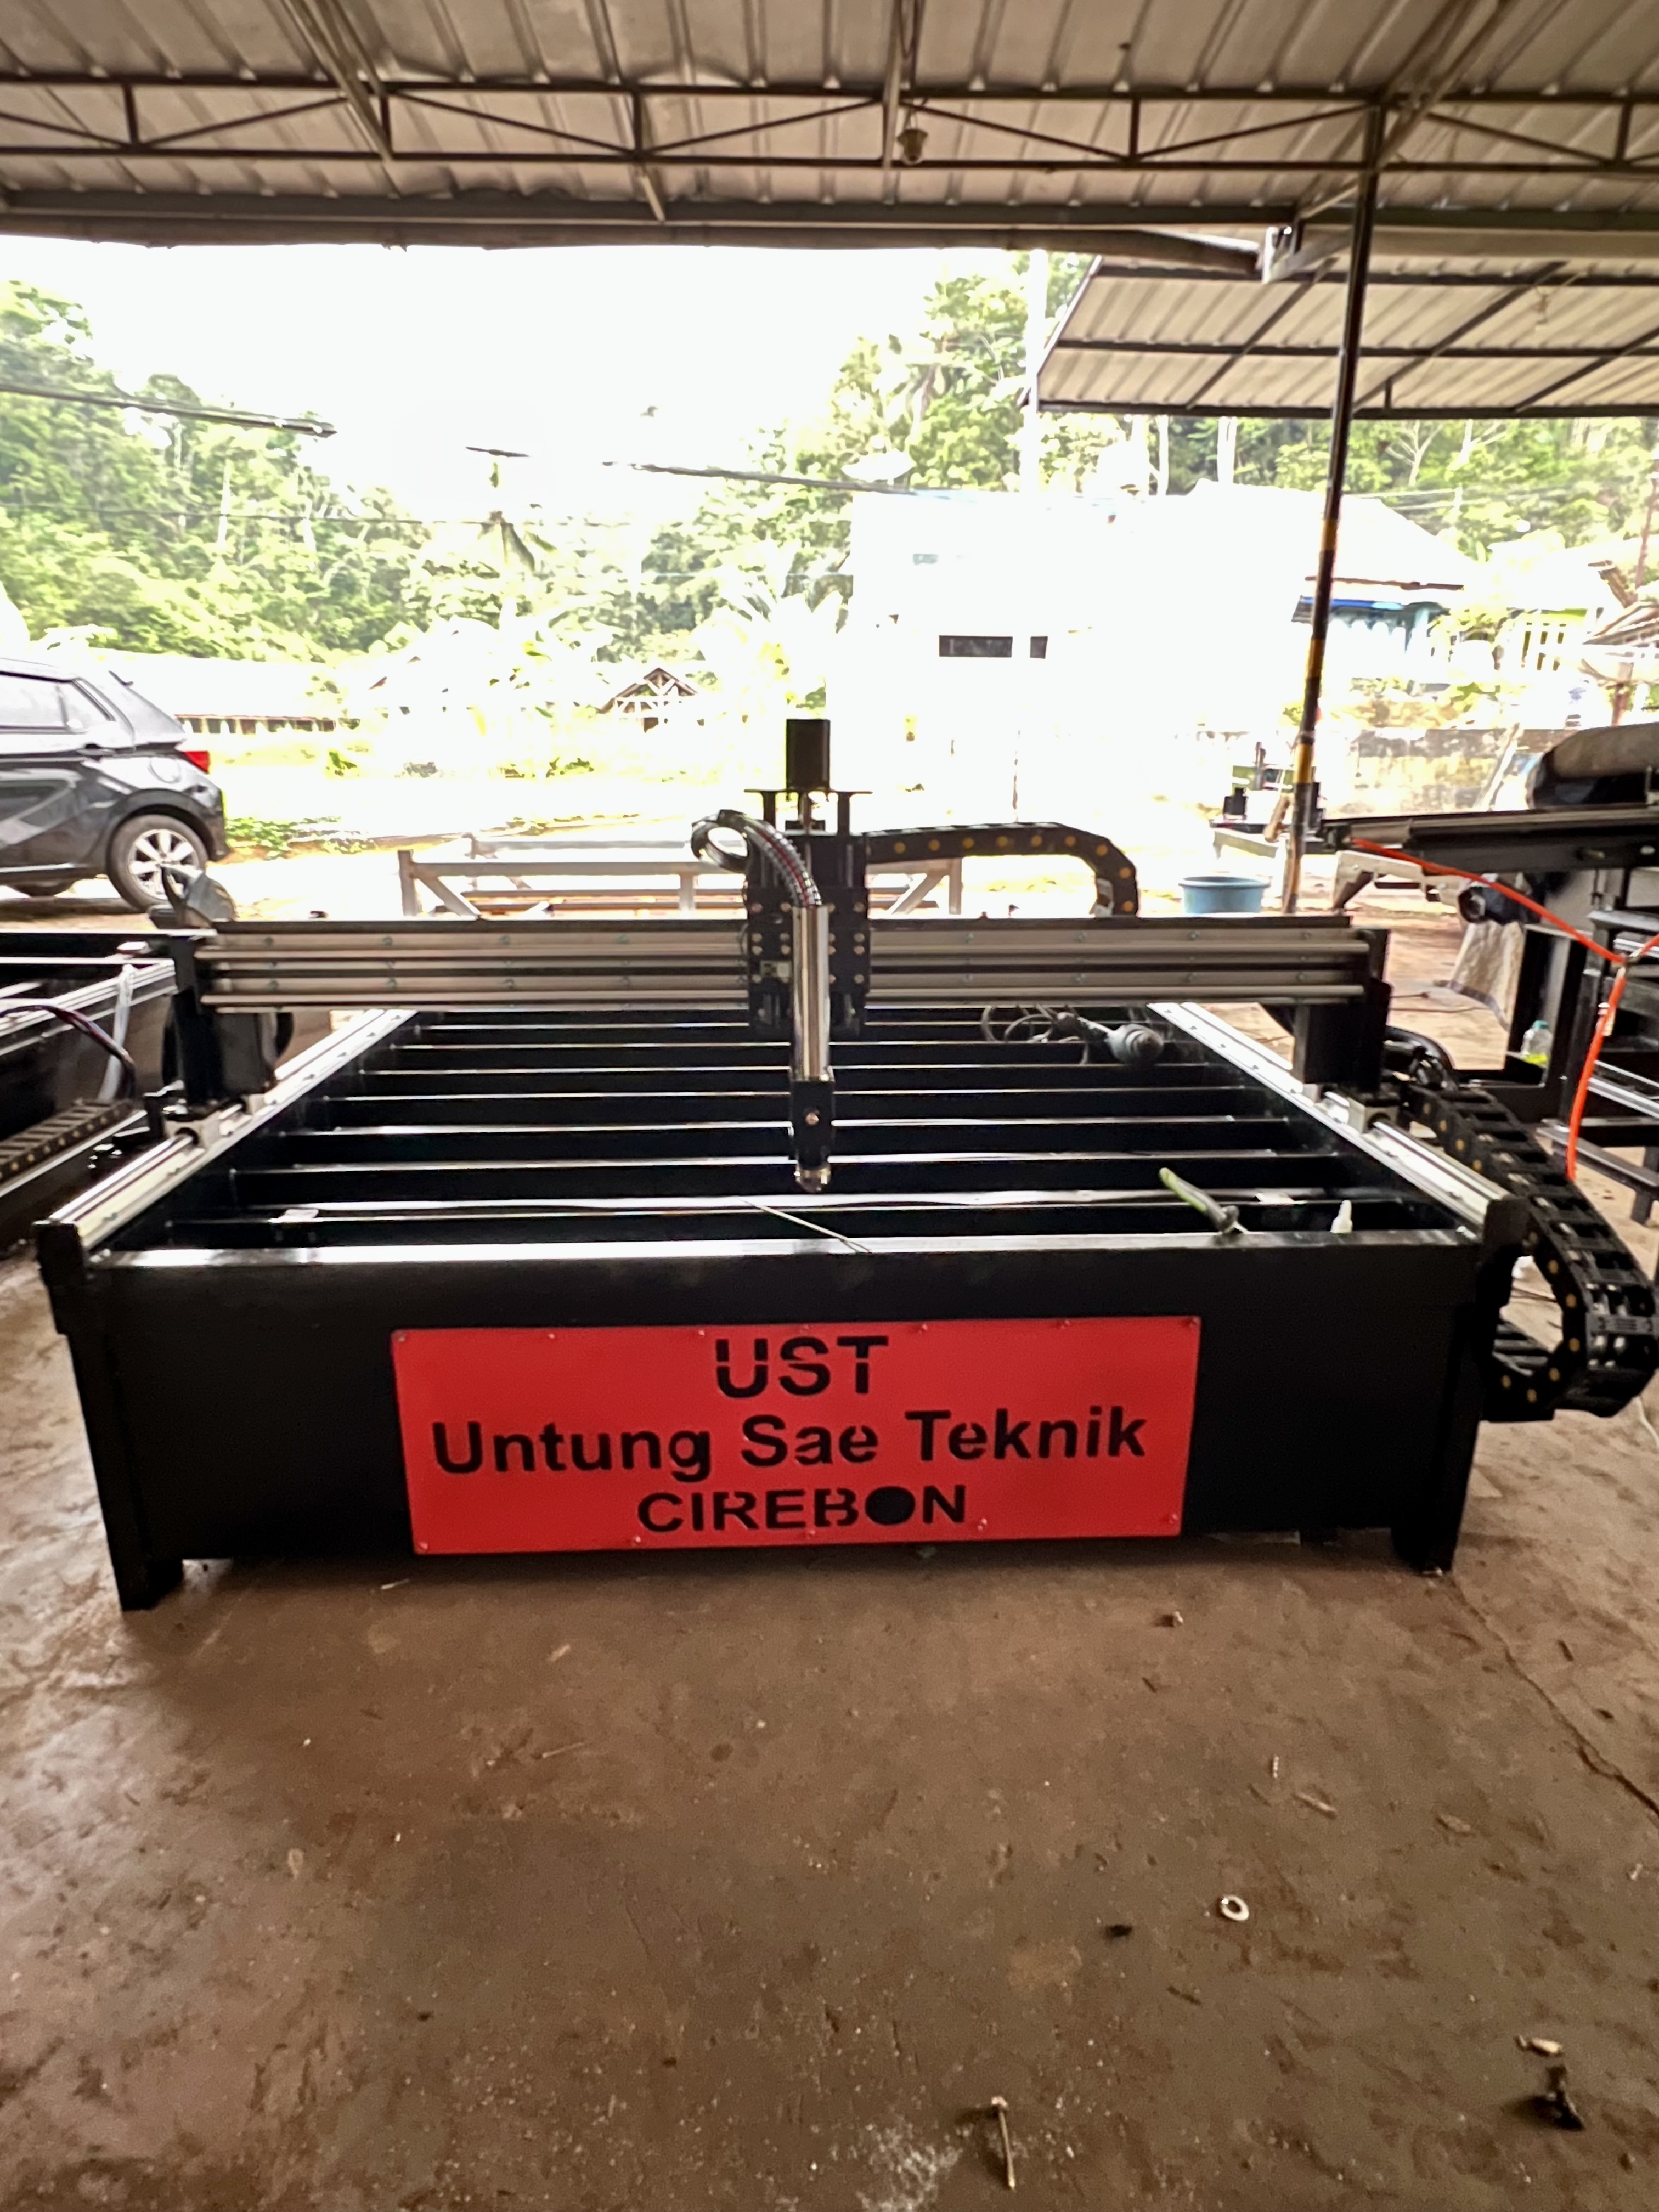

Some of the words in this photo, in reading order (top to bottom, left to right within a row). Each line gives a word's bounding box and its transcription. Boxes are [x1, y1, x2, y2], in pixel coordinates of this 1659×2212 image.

[715, 1335, 889, 1400] UST
[432, 1421, 712, 1484] Untung
[741, 1414, 879, 1468] Sae
[904, 1405, 1146, 1462] Teknik
[637, 1484, 966, 1533] CIREBON
